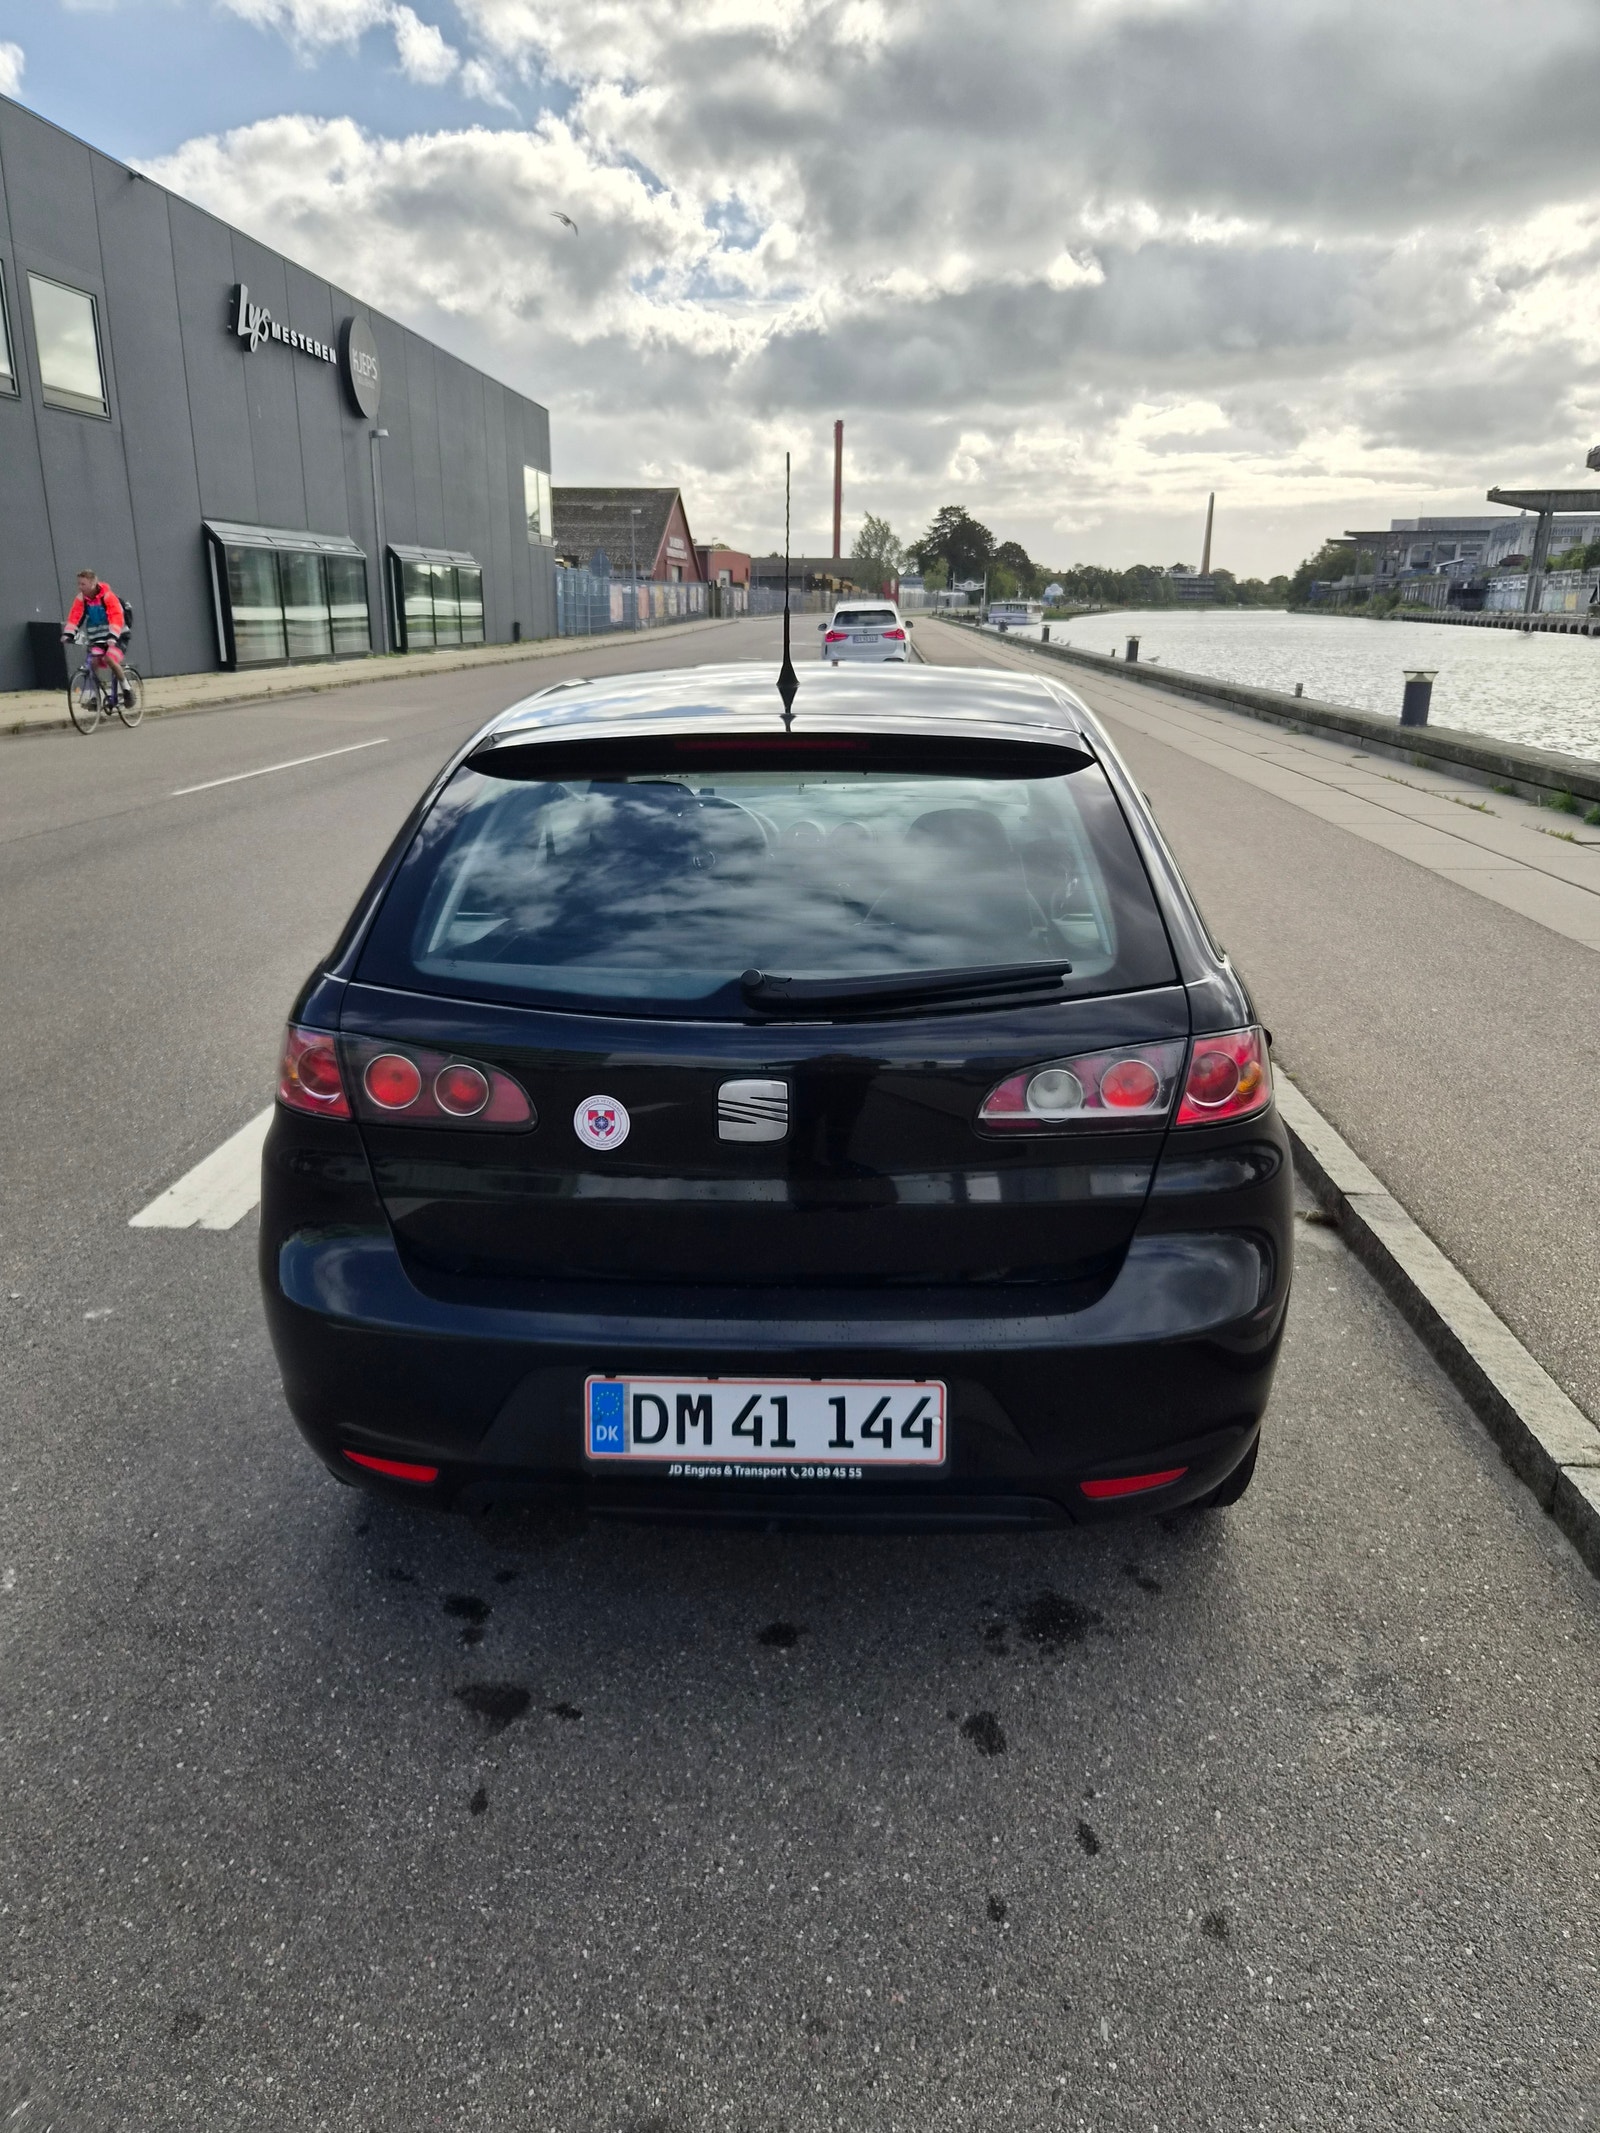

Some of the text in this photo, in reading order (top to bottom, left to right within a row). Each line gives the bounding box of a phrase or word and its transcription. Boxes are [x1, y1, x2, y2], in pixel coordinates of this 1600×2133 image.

[632, 1393, 934, 1449] DM 41 144
[596, 1425, 619, 1441] DK
[669, 1464, 863, 1479] JD Engros & Transport 20 89 45 55
